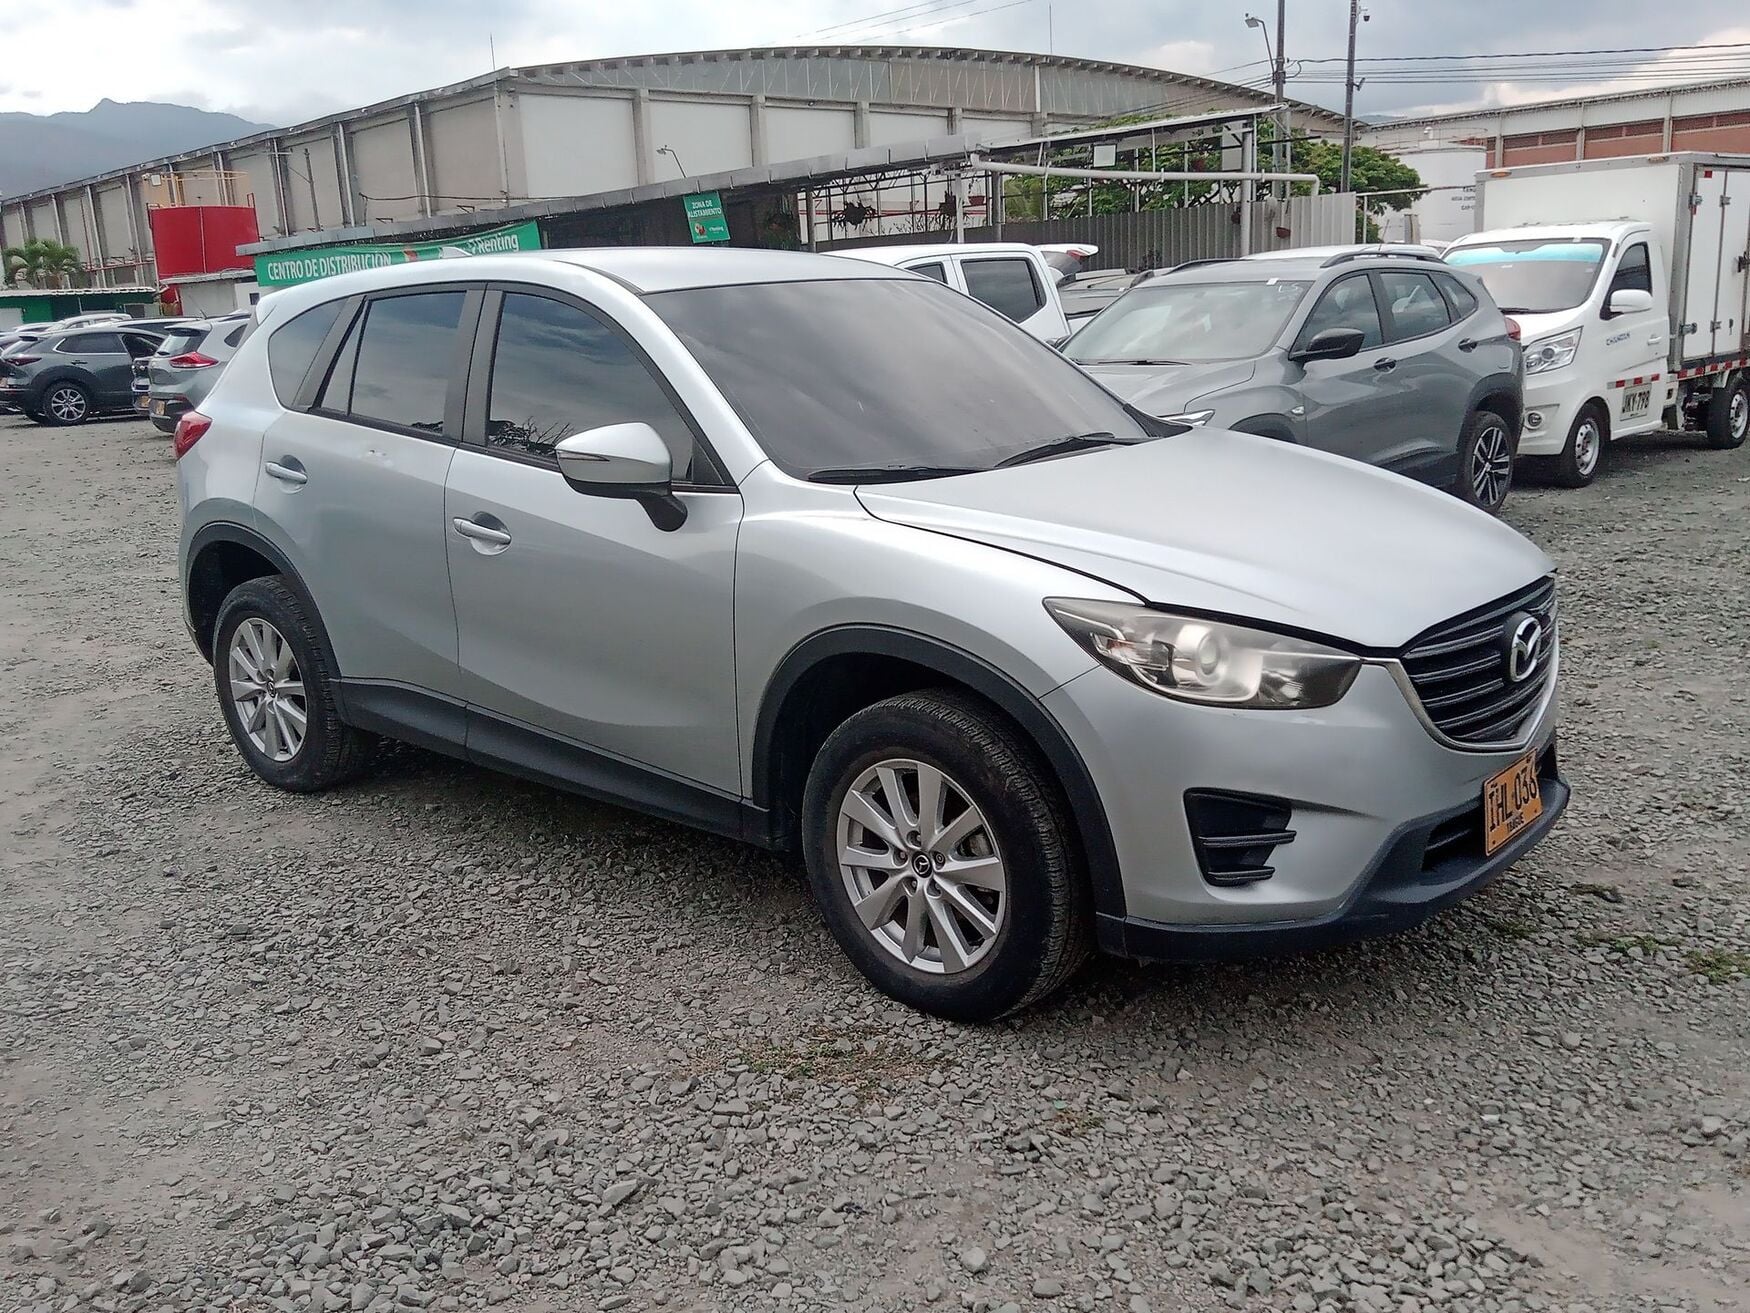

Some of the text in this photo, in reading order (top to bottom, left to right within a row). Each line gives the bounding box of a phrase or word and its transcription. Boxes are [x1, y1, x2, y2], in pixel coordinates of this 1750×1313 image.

[692, 201, 705, 209] ZONA
[477, 233, 520, 253] Renting
[267, 259, 304, 281] CENTRO
[304, 258, 319, 278] DE
